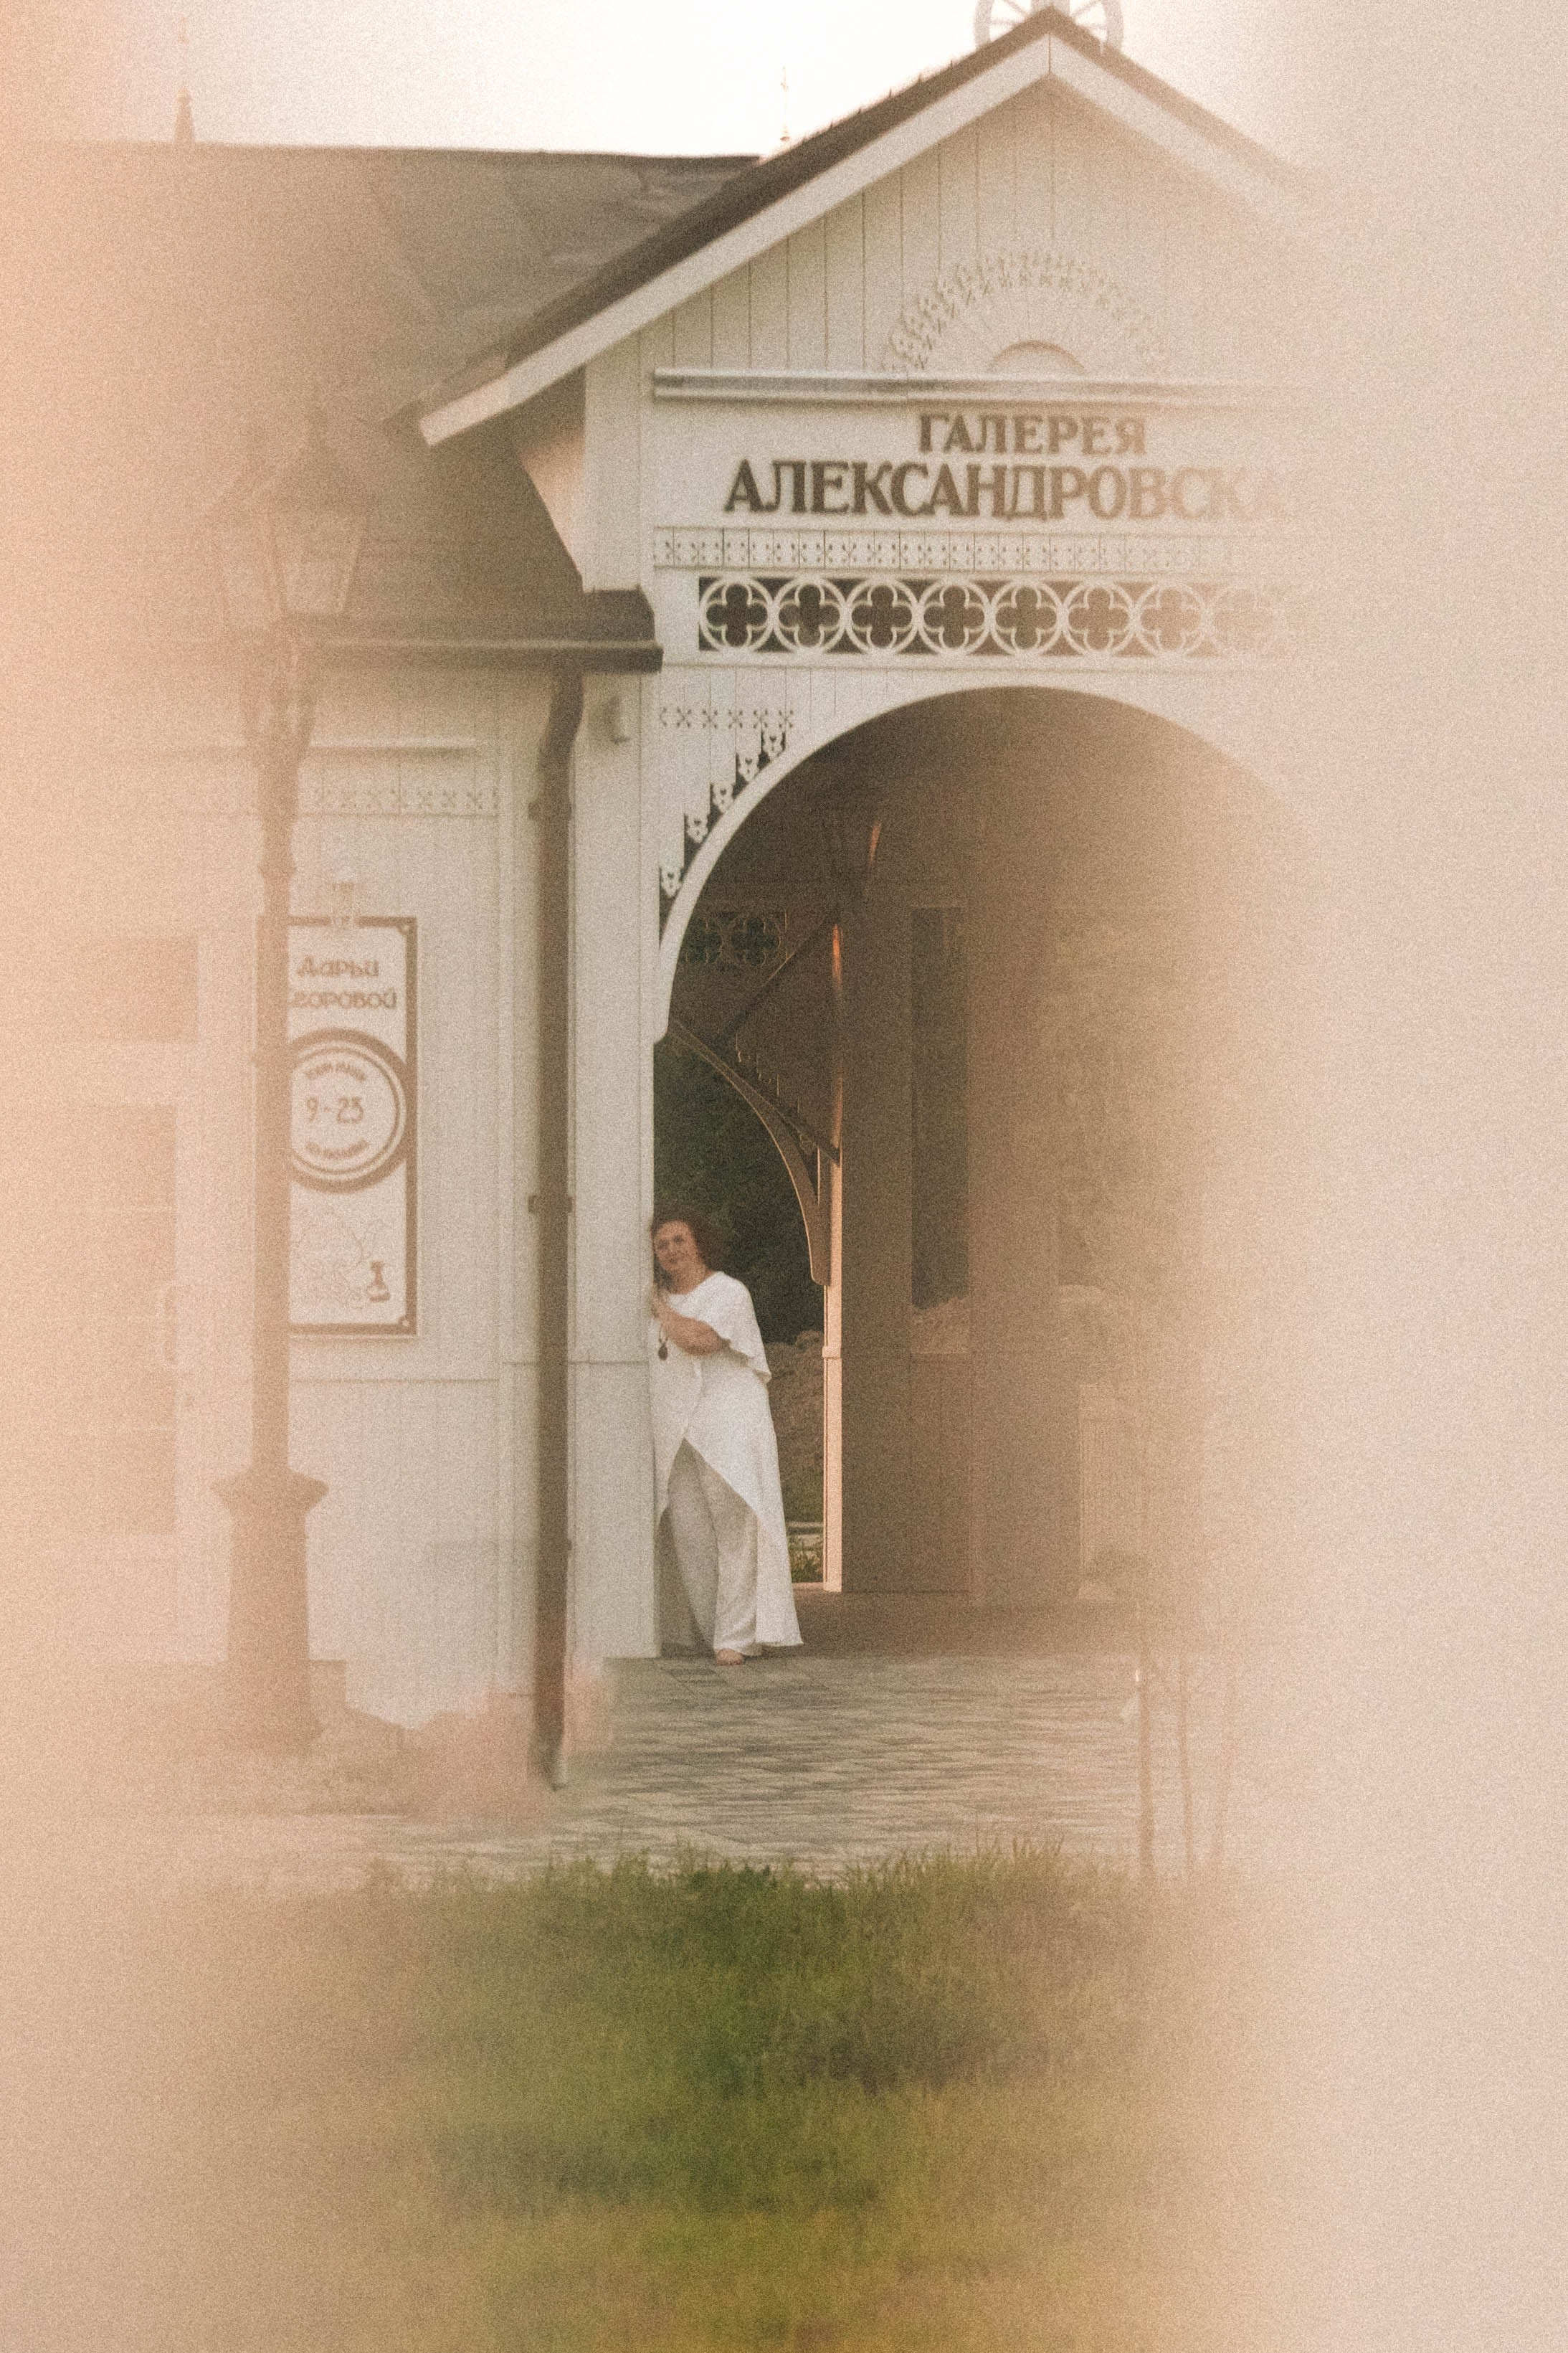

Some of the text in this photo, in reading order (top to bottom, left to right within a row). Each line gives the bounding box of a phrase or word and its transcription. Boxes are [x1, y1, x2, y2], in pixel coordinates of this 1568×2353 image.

[918, 413, 1146, 455] ГАЛЕРЕЯ
[723, 458, 1323, 523] АЛЕКСАНДРОВСКА
[296, 955, 379, 978] Дарьи
[288, 987, 397, 1009] горовой
